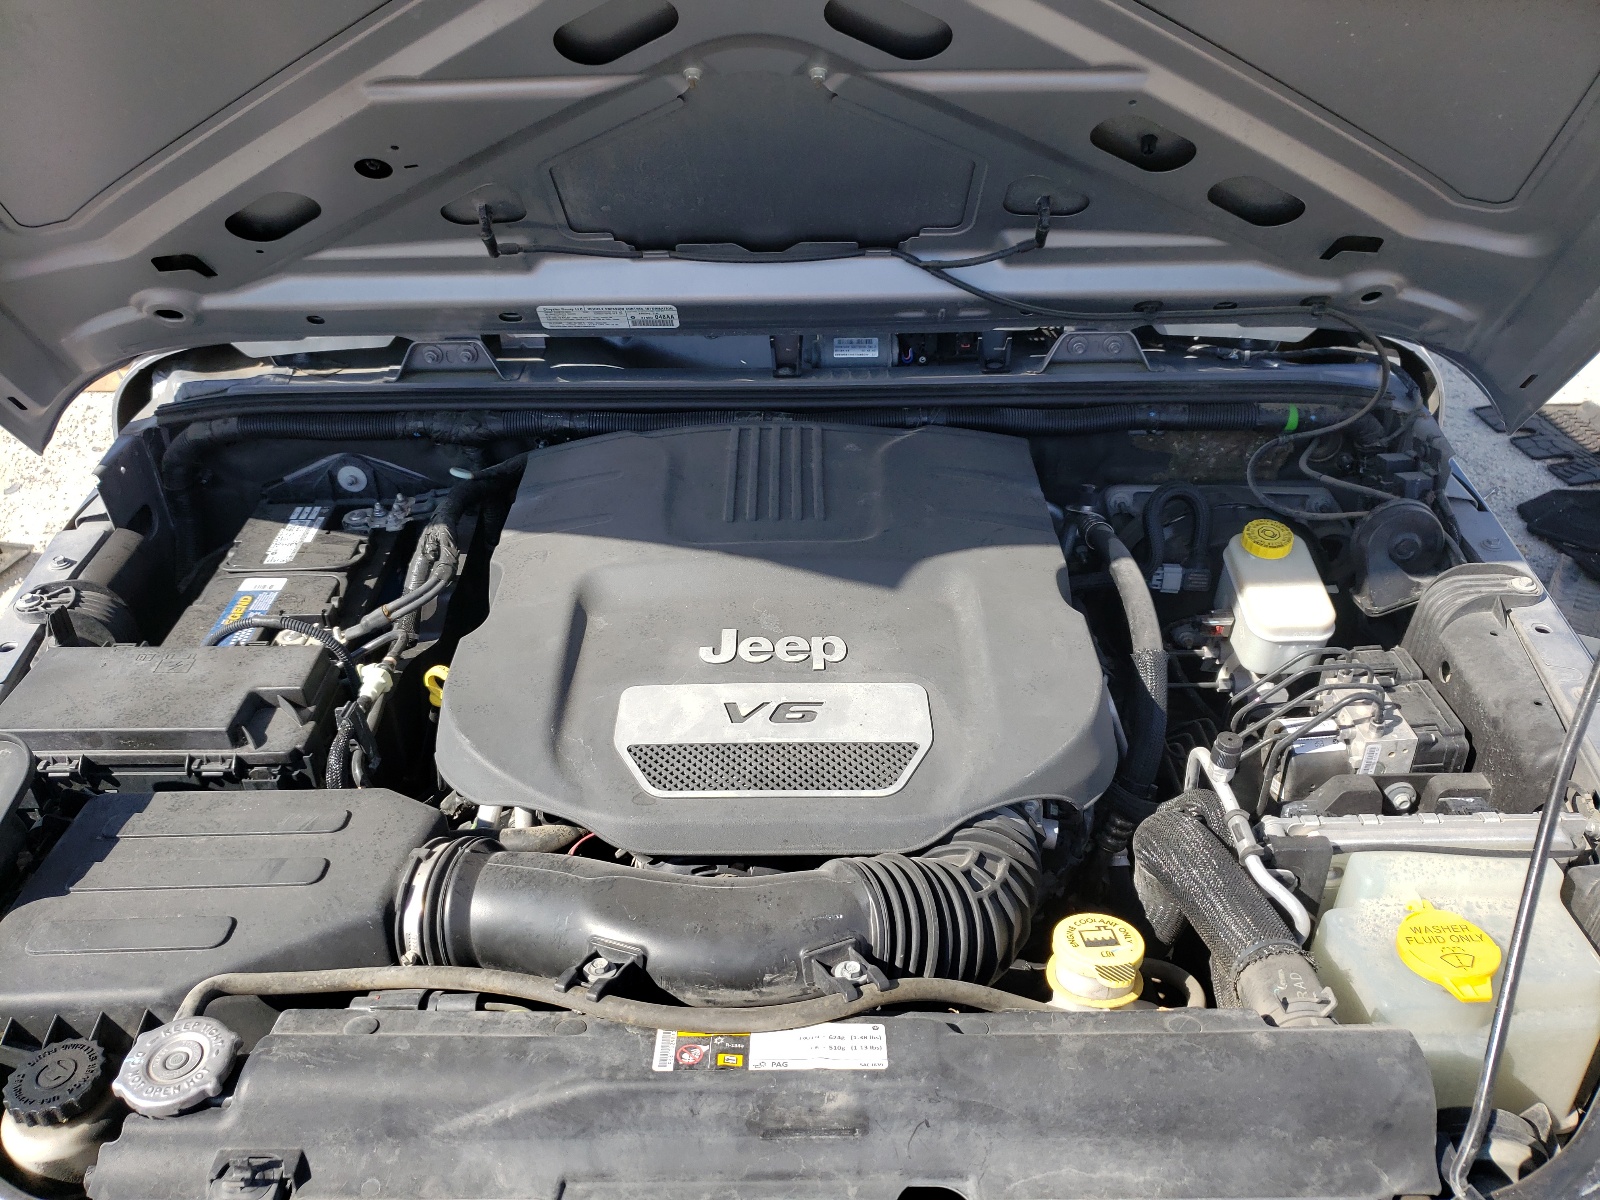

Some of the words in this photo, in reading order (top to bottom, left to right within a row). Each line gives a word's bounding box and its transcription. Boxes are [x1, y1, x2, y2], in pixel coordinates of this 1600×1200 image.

[699, 628, 848, 671] Jeep
[723, 701, 825, 723] V6
[1066, 925, 1080, 948] ENGINE
[1074, 918, 1119, 928] COOLANT
[1118, 927, 1134, 944] ONLY
[1405, 935, 1446, 945] FLUID
[1449, 933, 1484, 943] ONLY
[1409, 924, 1471, 935] WASHER
[161, 1021, 200, 1038] KEEP
[202, 1023, 225, 1047] TIGHT
[143, 1085, 181, 1098] OPEN
[183, 1066, 211, 1089] HOT
